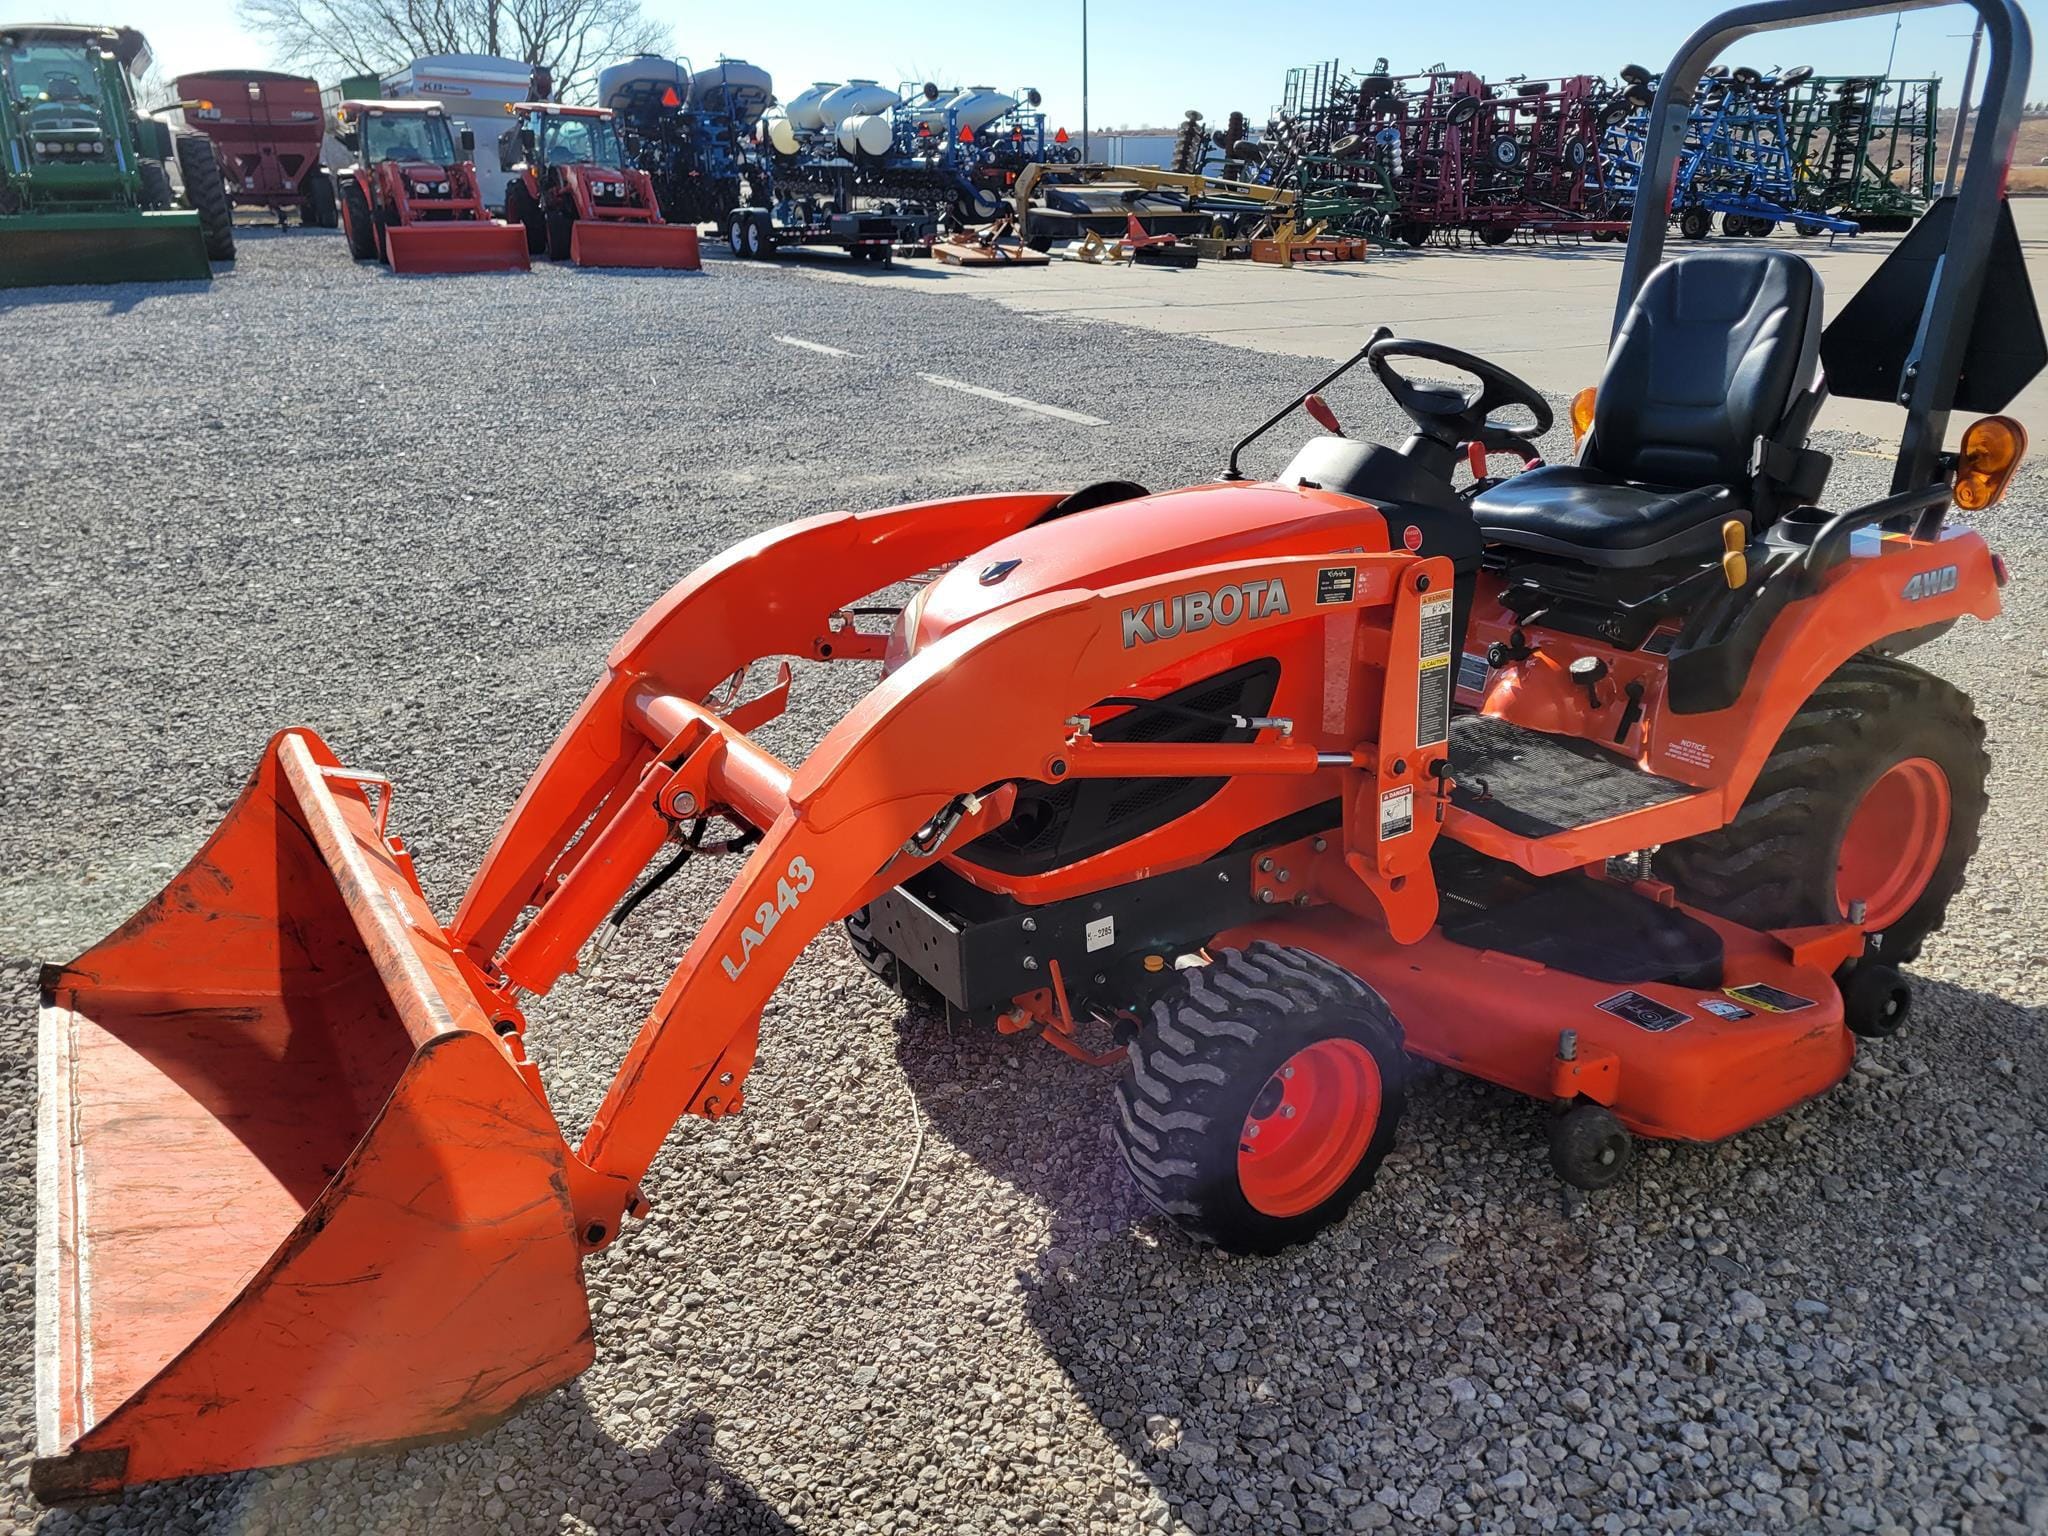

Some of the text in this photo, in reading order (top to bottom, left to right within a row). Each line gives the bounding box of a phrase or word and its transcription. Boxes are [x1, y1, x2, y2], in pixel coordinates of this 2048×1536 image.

[1900, 564, 1958, 601] 4WD
[1121, 578, 1290, 649] KUBOTA
[1426, 658, 1448, 668] CAUTION
[1680, 739, 1707, 752] NOTICE
[1388, 787, 1411, 799] DANGER
[721, 856, 815, 982] LA243
